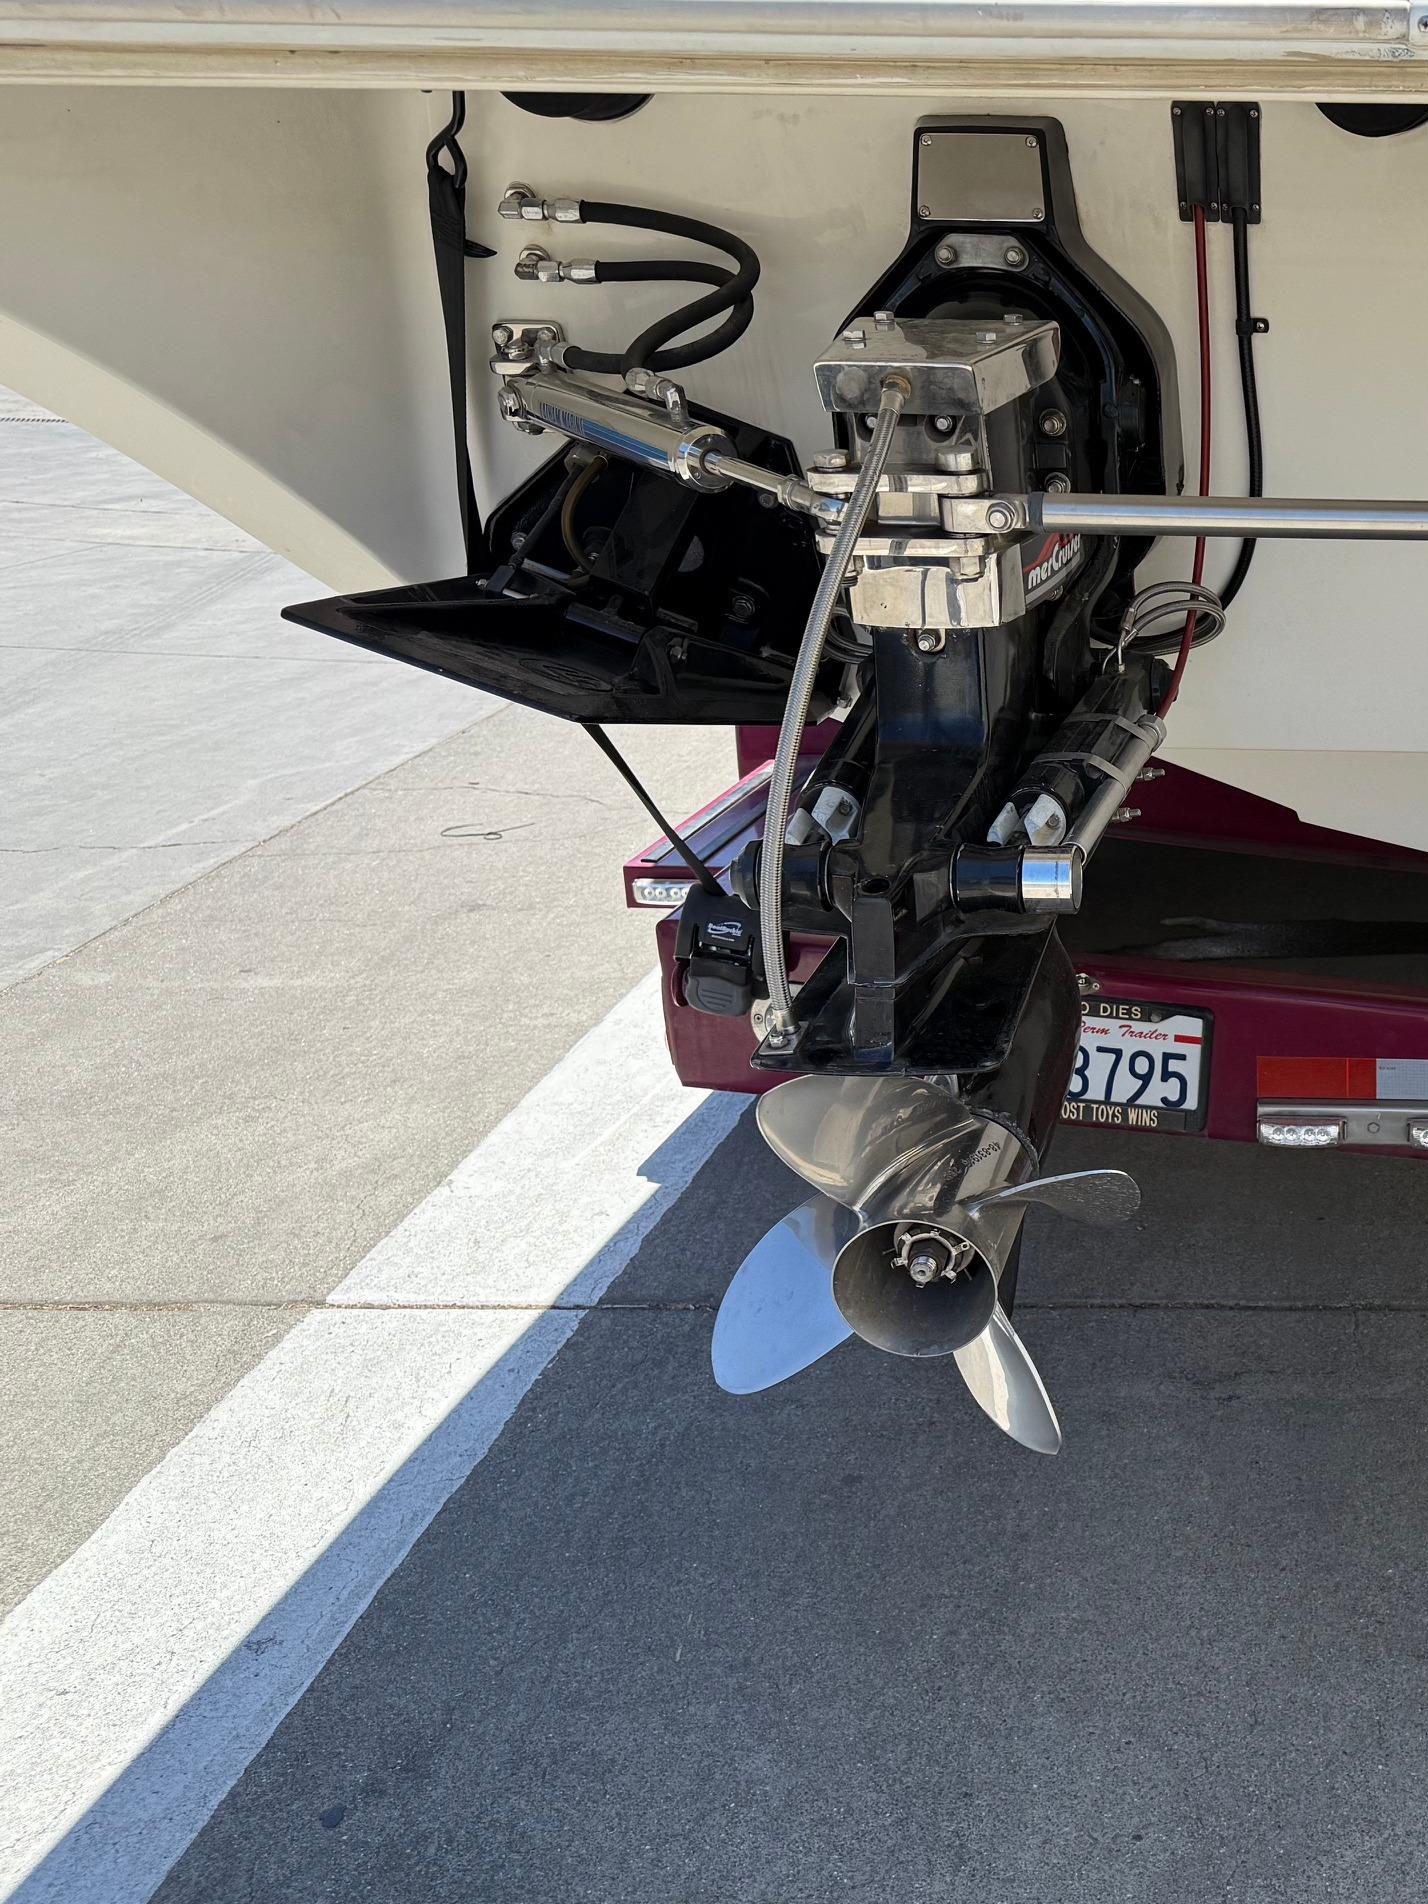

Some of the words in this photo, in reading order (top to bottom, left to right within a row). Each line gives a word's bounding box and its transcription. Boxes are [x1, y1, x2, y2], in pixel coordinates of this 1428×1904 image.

[1100, 1003, 1141, 1019] DIES
[1119, 1024, 1169, 1041] Trailer
[1060, 1102, 1085, 1120] OST
[1091, 1104, 1122, 1124] TOYS
[1128, 1107, 1158, 1127] WINS
